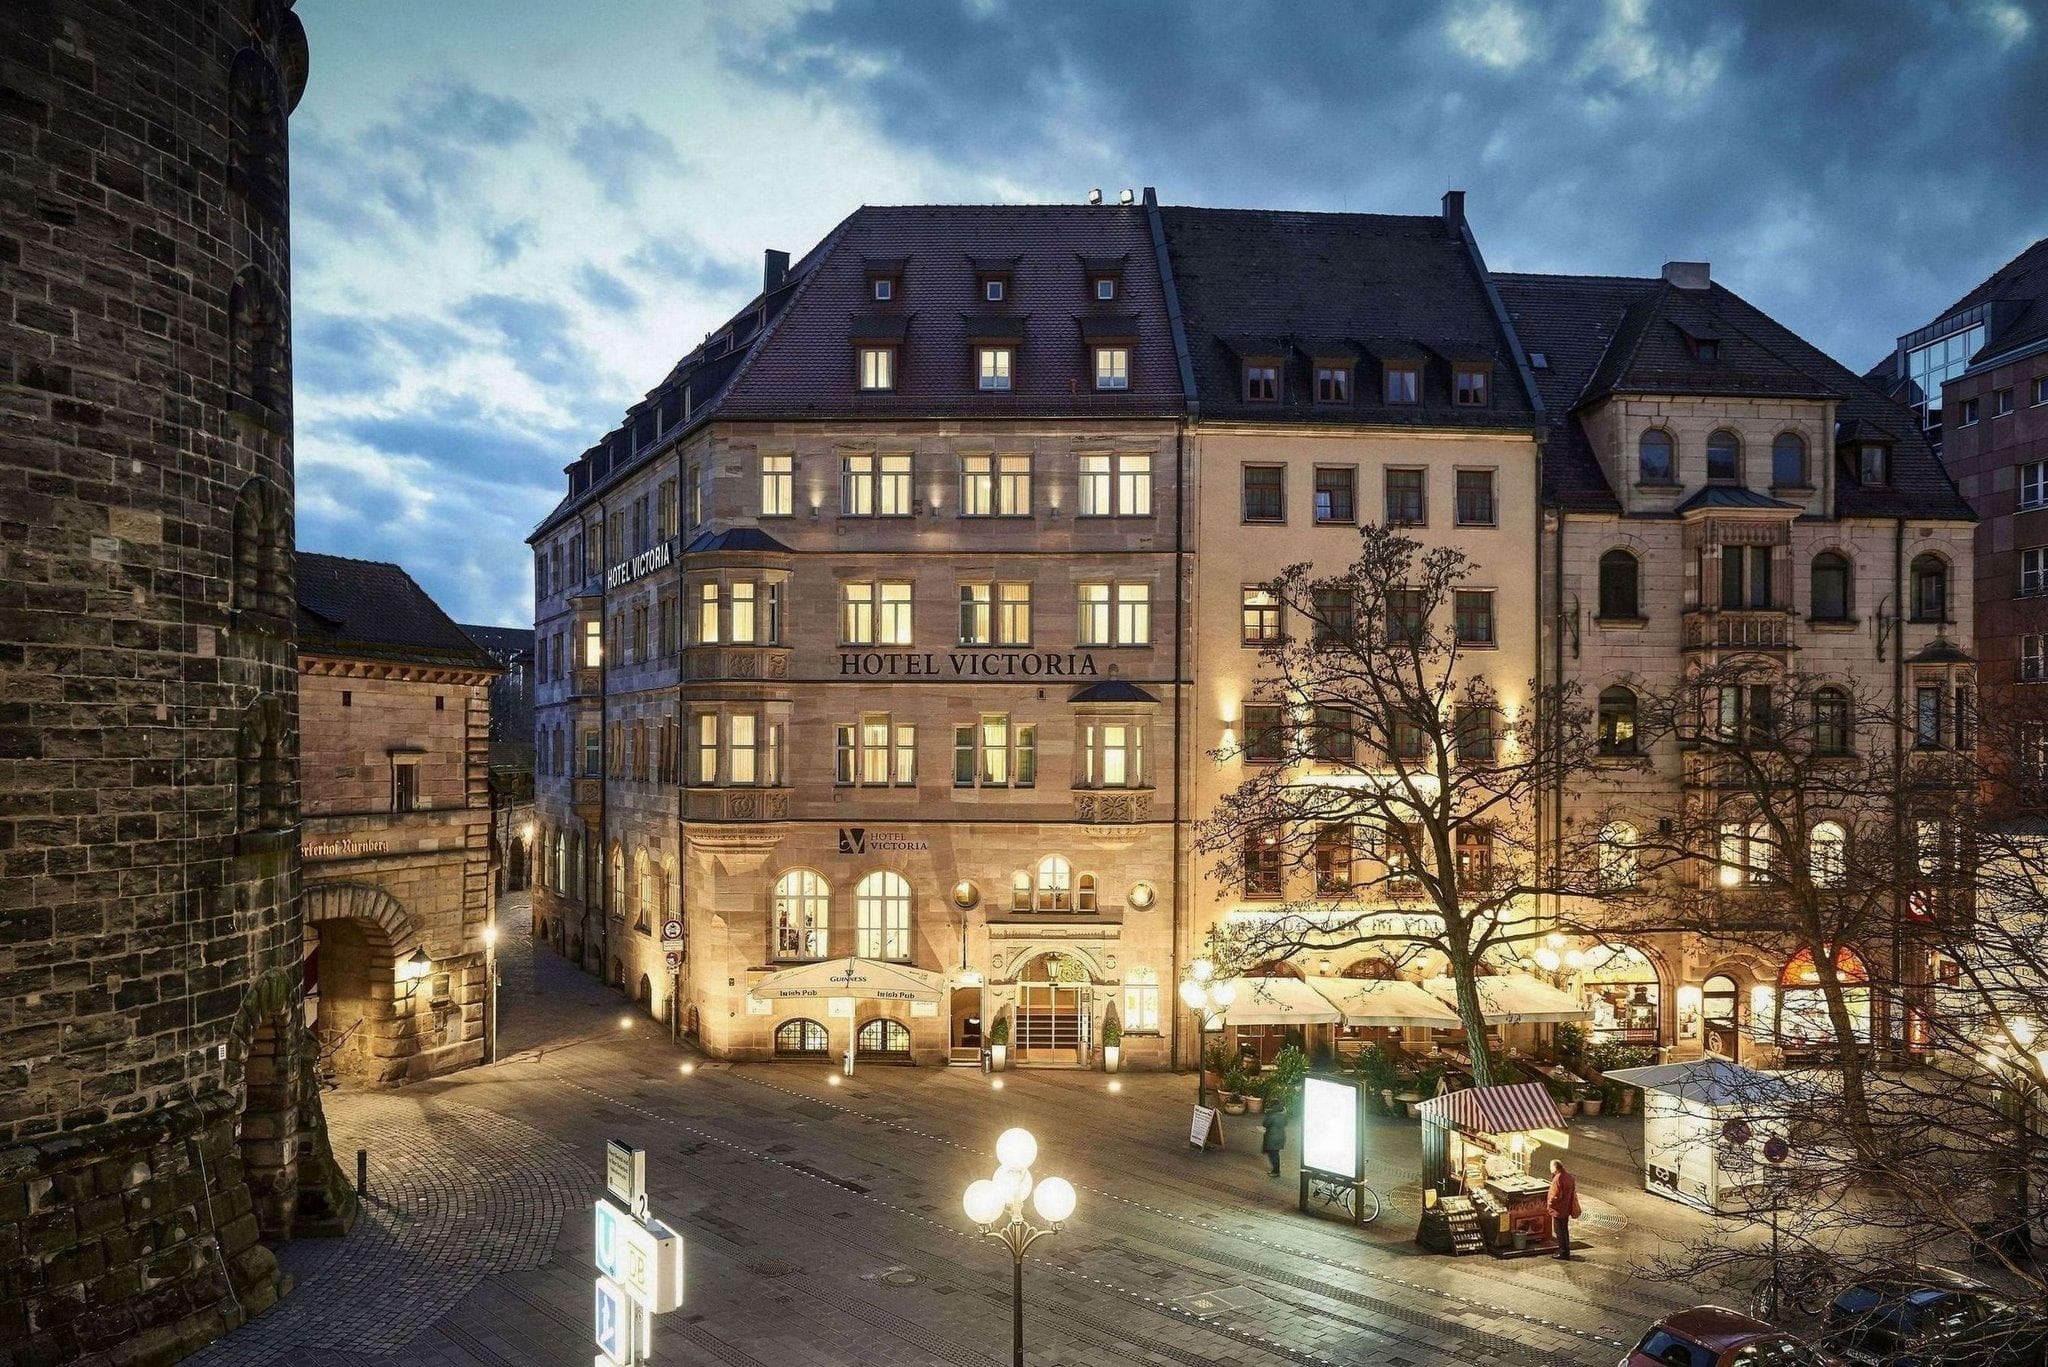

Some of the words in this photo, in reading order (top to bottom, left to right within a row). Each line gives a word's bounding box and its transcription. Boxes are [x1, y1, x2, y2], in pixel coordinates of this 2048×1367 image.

[607, 561, 631, 590] HOTEL
[632, 541, 670, 579] VICTORIA
[839, 653, 941, 676] HOTEL
[948, 652, 1099, 676] VICTORIA
[870, 832, 907, 841] HOTEL
[870, 841, 928, 850] VICTORIA
[829, 975, 868, 983] GUINNESS
[779, 989, 801, 997] Irish
[802, 989, 818, 997] Pub
[877, 990, 898, 999] Irish
[899, 991, 915, 1000] Pub
